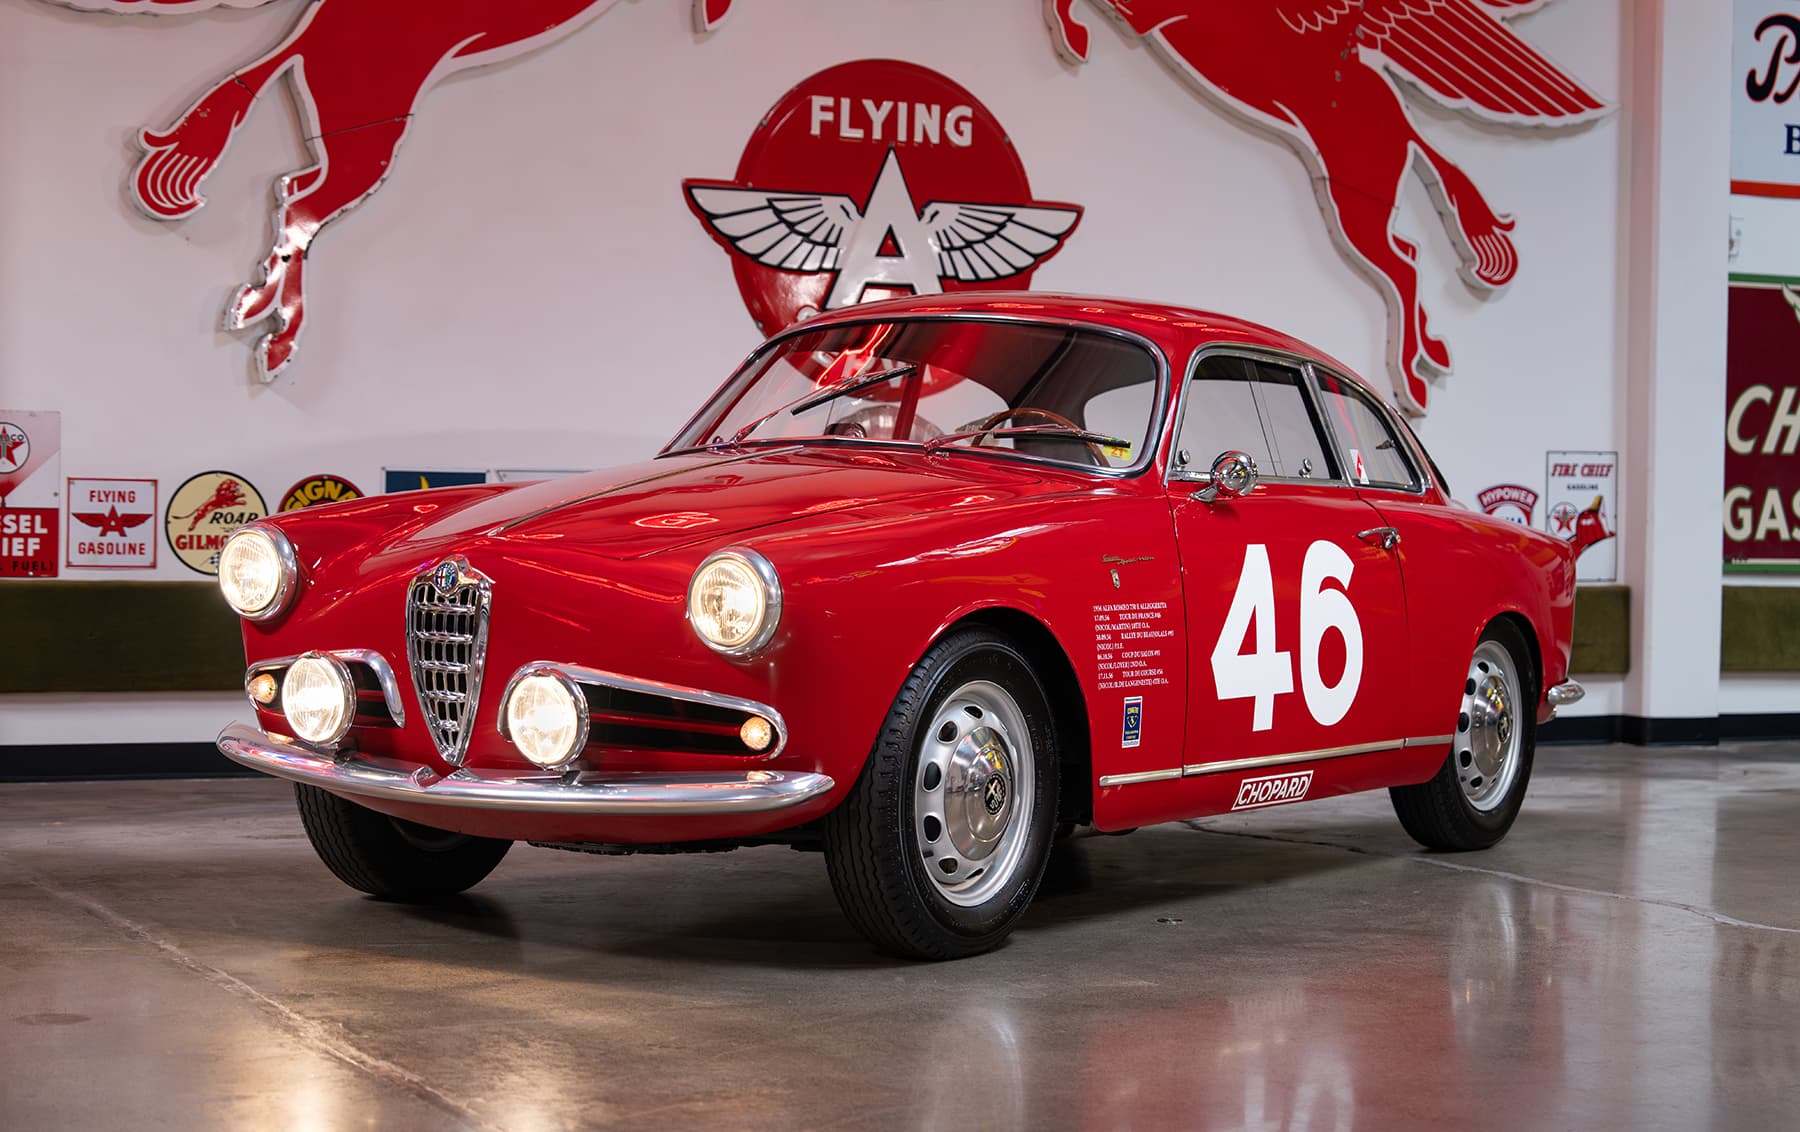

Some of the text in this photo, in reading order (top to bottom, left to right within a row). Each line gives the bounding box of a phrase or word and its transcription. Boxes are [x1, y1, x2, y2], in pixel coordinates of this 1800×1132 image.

[810, 95, 973, 147] FLYING
[1726, 384, 1800, 455] CH
[1551, 463, 1613, 477] FIRE CHIEF
[89, 490, 136, 503] FLYING
[1481, 486, 1535, 506] HYPOWER
[1724, 485, 1800, 542] GA
[78, 542, 146, 555] GASOLINE
[1210, 539, 1363, 732] 46
[1237, 775, 1310, 806] CHOPARD
